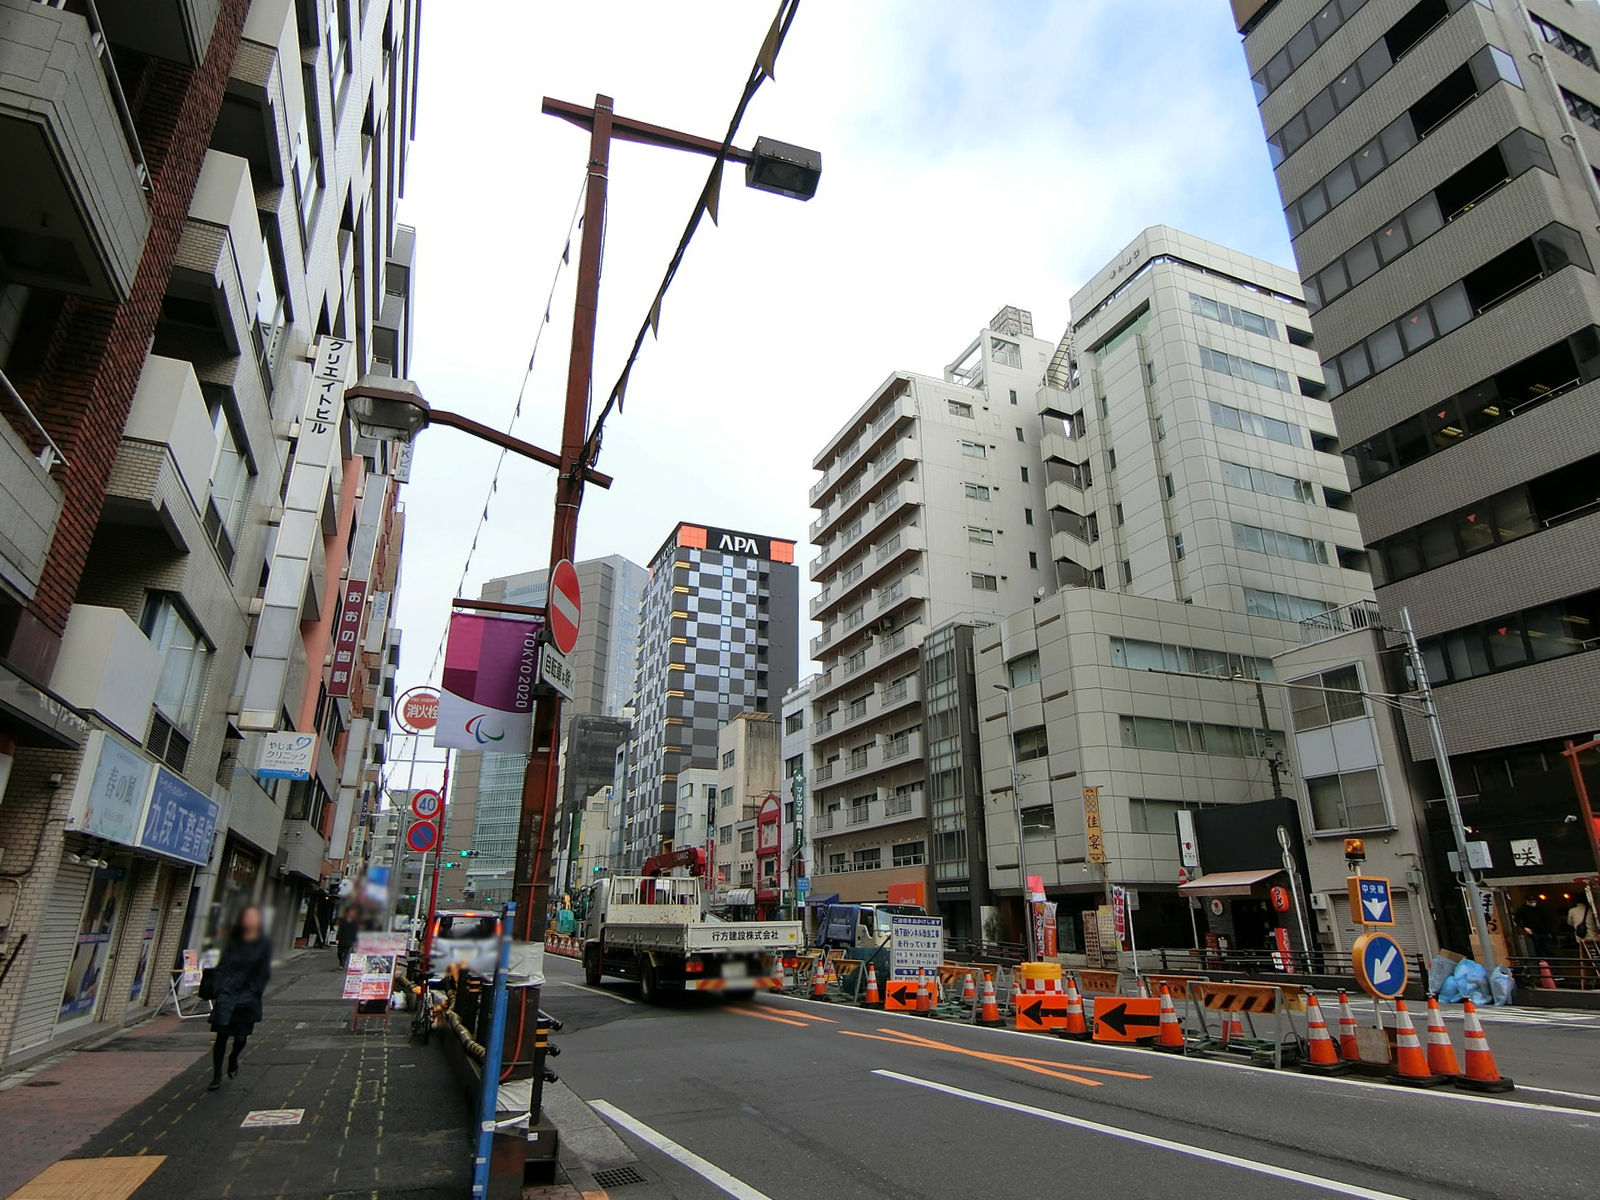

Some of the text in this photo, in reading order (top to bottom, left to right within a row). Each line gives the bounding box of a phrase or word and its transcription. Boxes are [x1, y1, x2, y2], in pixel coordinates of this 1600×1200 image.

[311, 341, 345, 435] クリエイトビル
[719, 534, 759, 554] APA
[332, 591, 362, 684] おおの歯科
[515, 631, 537, 709] TOKYO 2020
[269, 741, 294, 751] やじま
[266, 750, 307, 761] クリニック
[292, 767, 306, 777] 2F
[418, 797, 437, 812] 40
[145, 792, 213, 860] 九段下整骨院
[1512, 846, 1538, 866] 咲
[893, 917, 941, 925] ご迷惑をおかけします
[712, 930, 779, 941] 行方建設株式会社
[898, 940, 937, 948] を行っています
